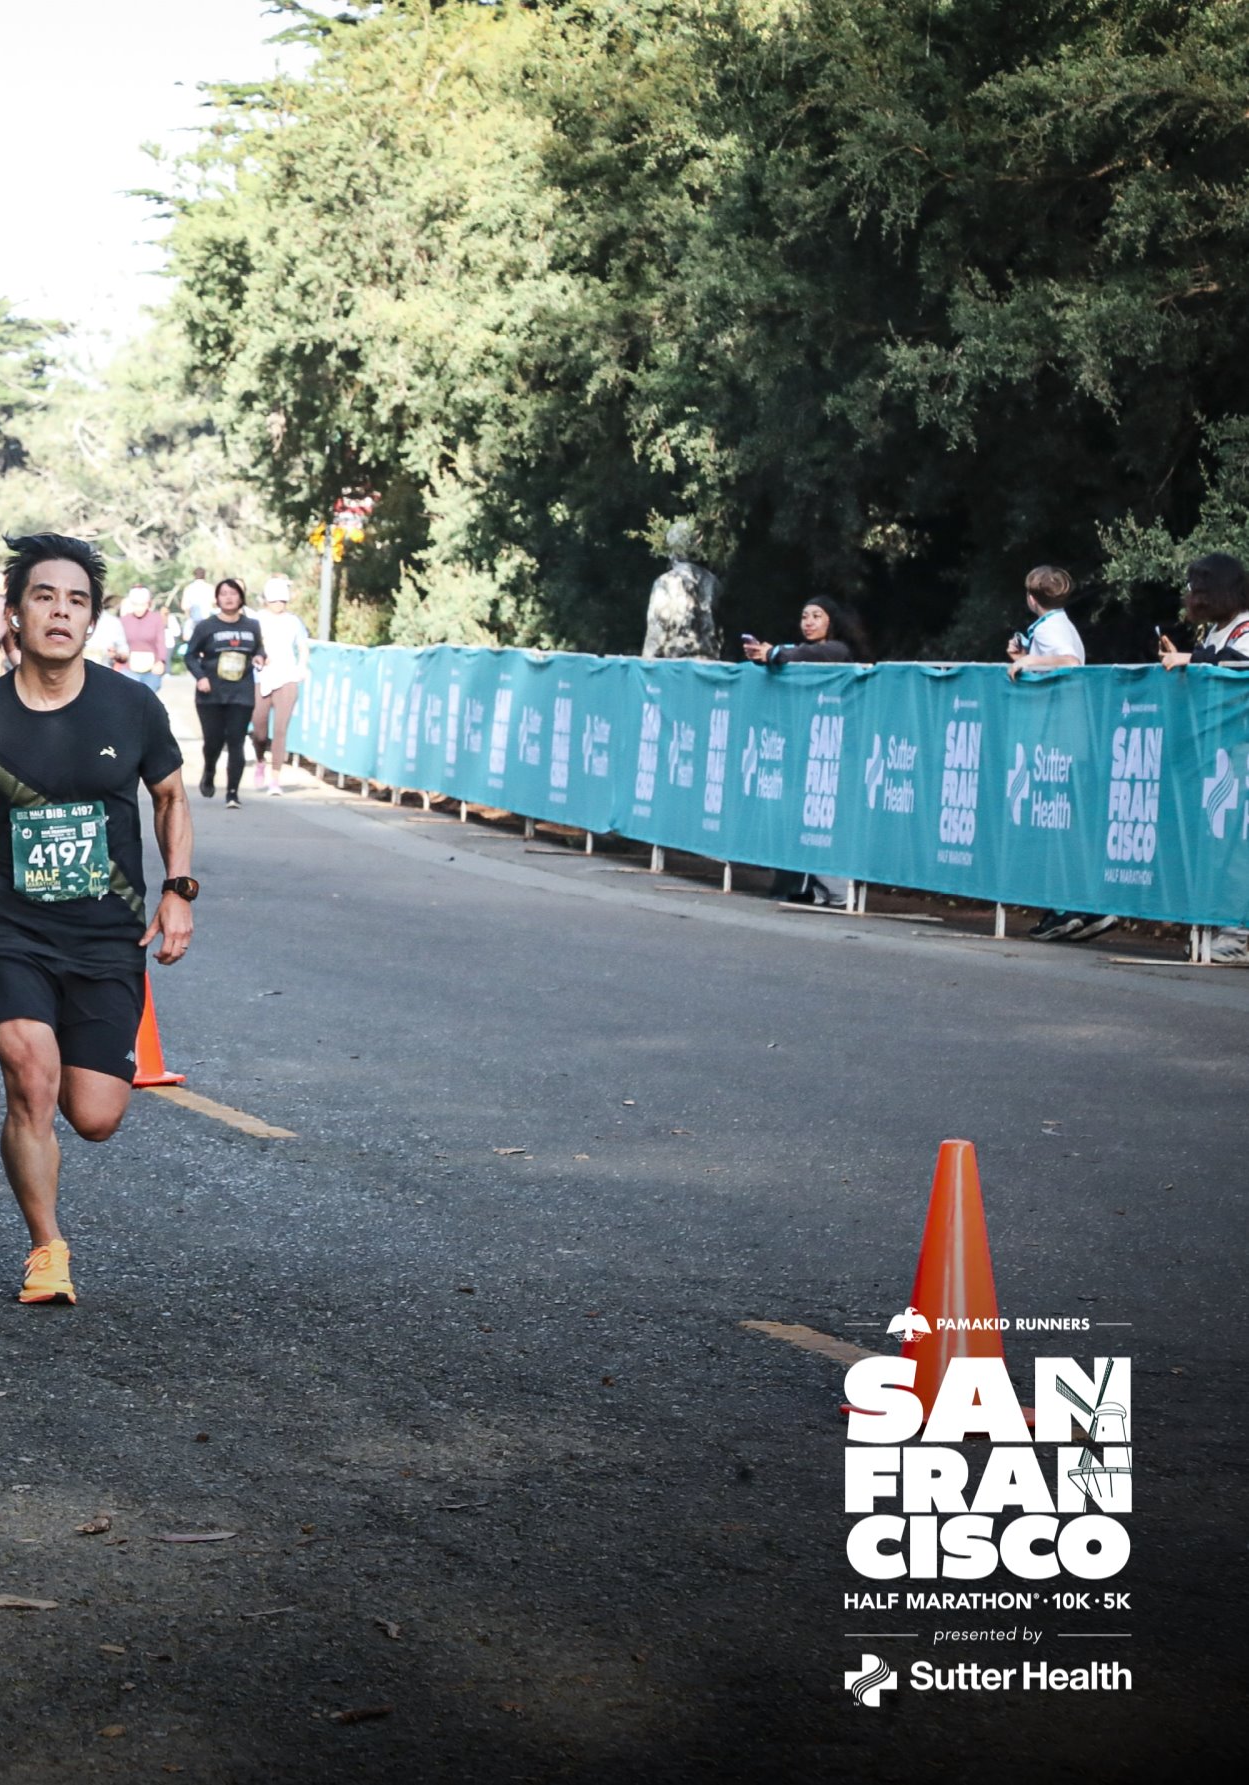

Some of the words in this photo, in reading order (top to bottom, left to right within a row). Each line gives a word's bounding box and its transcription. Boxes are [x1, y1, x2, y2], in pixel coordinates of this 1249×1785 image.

[808, 714, 845, 760] SAN
[886, 734, 918, 771] Sutter
[944, 720, 982, 770] SAN
[1111, 726, 1163, 780] SAN
[1033, 743, 1073, 783] Sutter
[883, 777, 915, 814] Health
[941, 769, 979, 810] FRAN
[1108, 780, 1160, 823] FRAN
[45, 808, 67, 819] BIB:
[71, 805, 93, 817] 4197
[939, 806, 976, 846] CISCO
[1031, 790, 1072, 830] Health
[28, 839, 93, 868] 4197
[1107, 820, 1156, 863] CISCO
[24, 868, 60, 882] HALF
[1104, 867, 1119, 883] HALF
